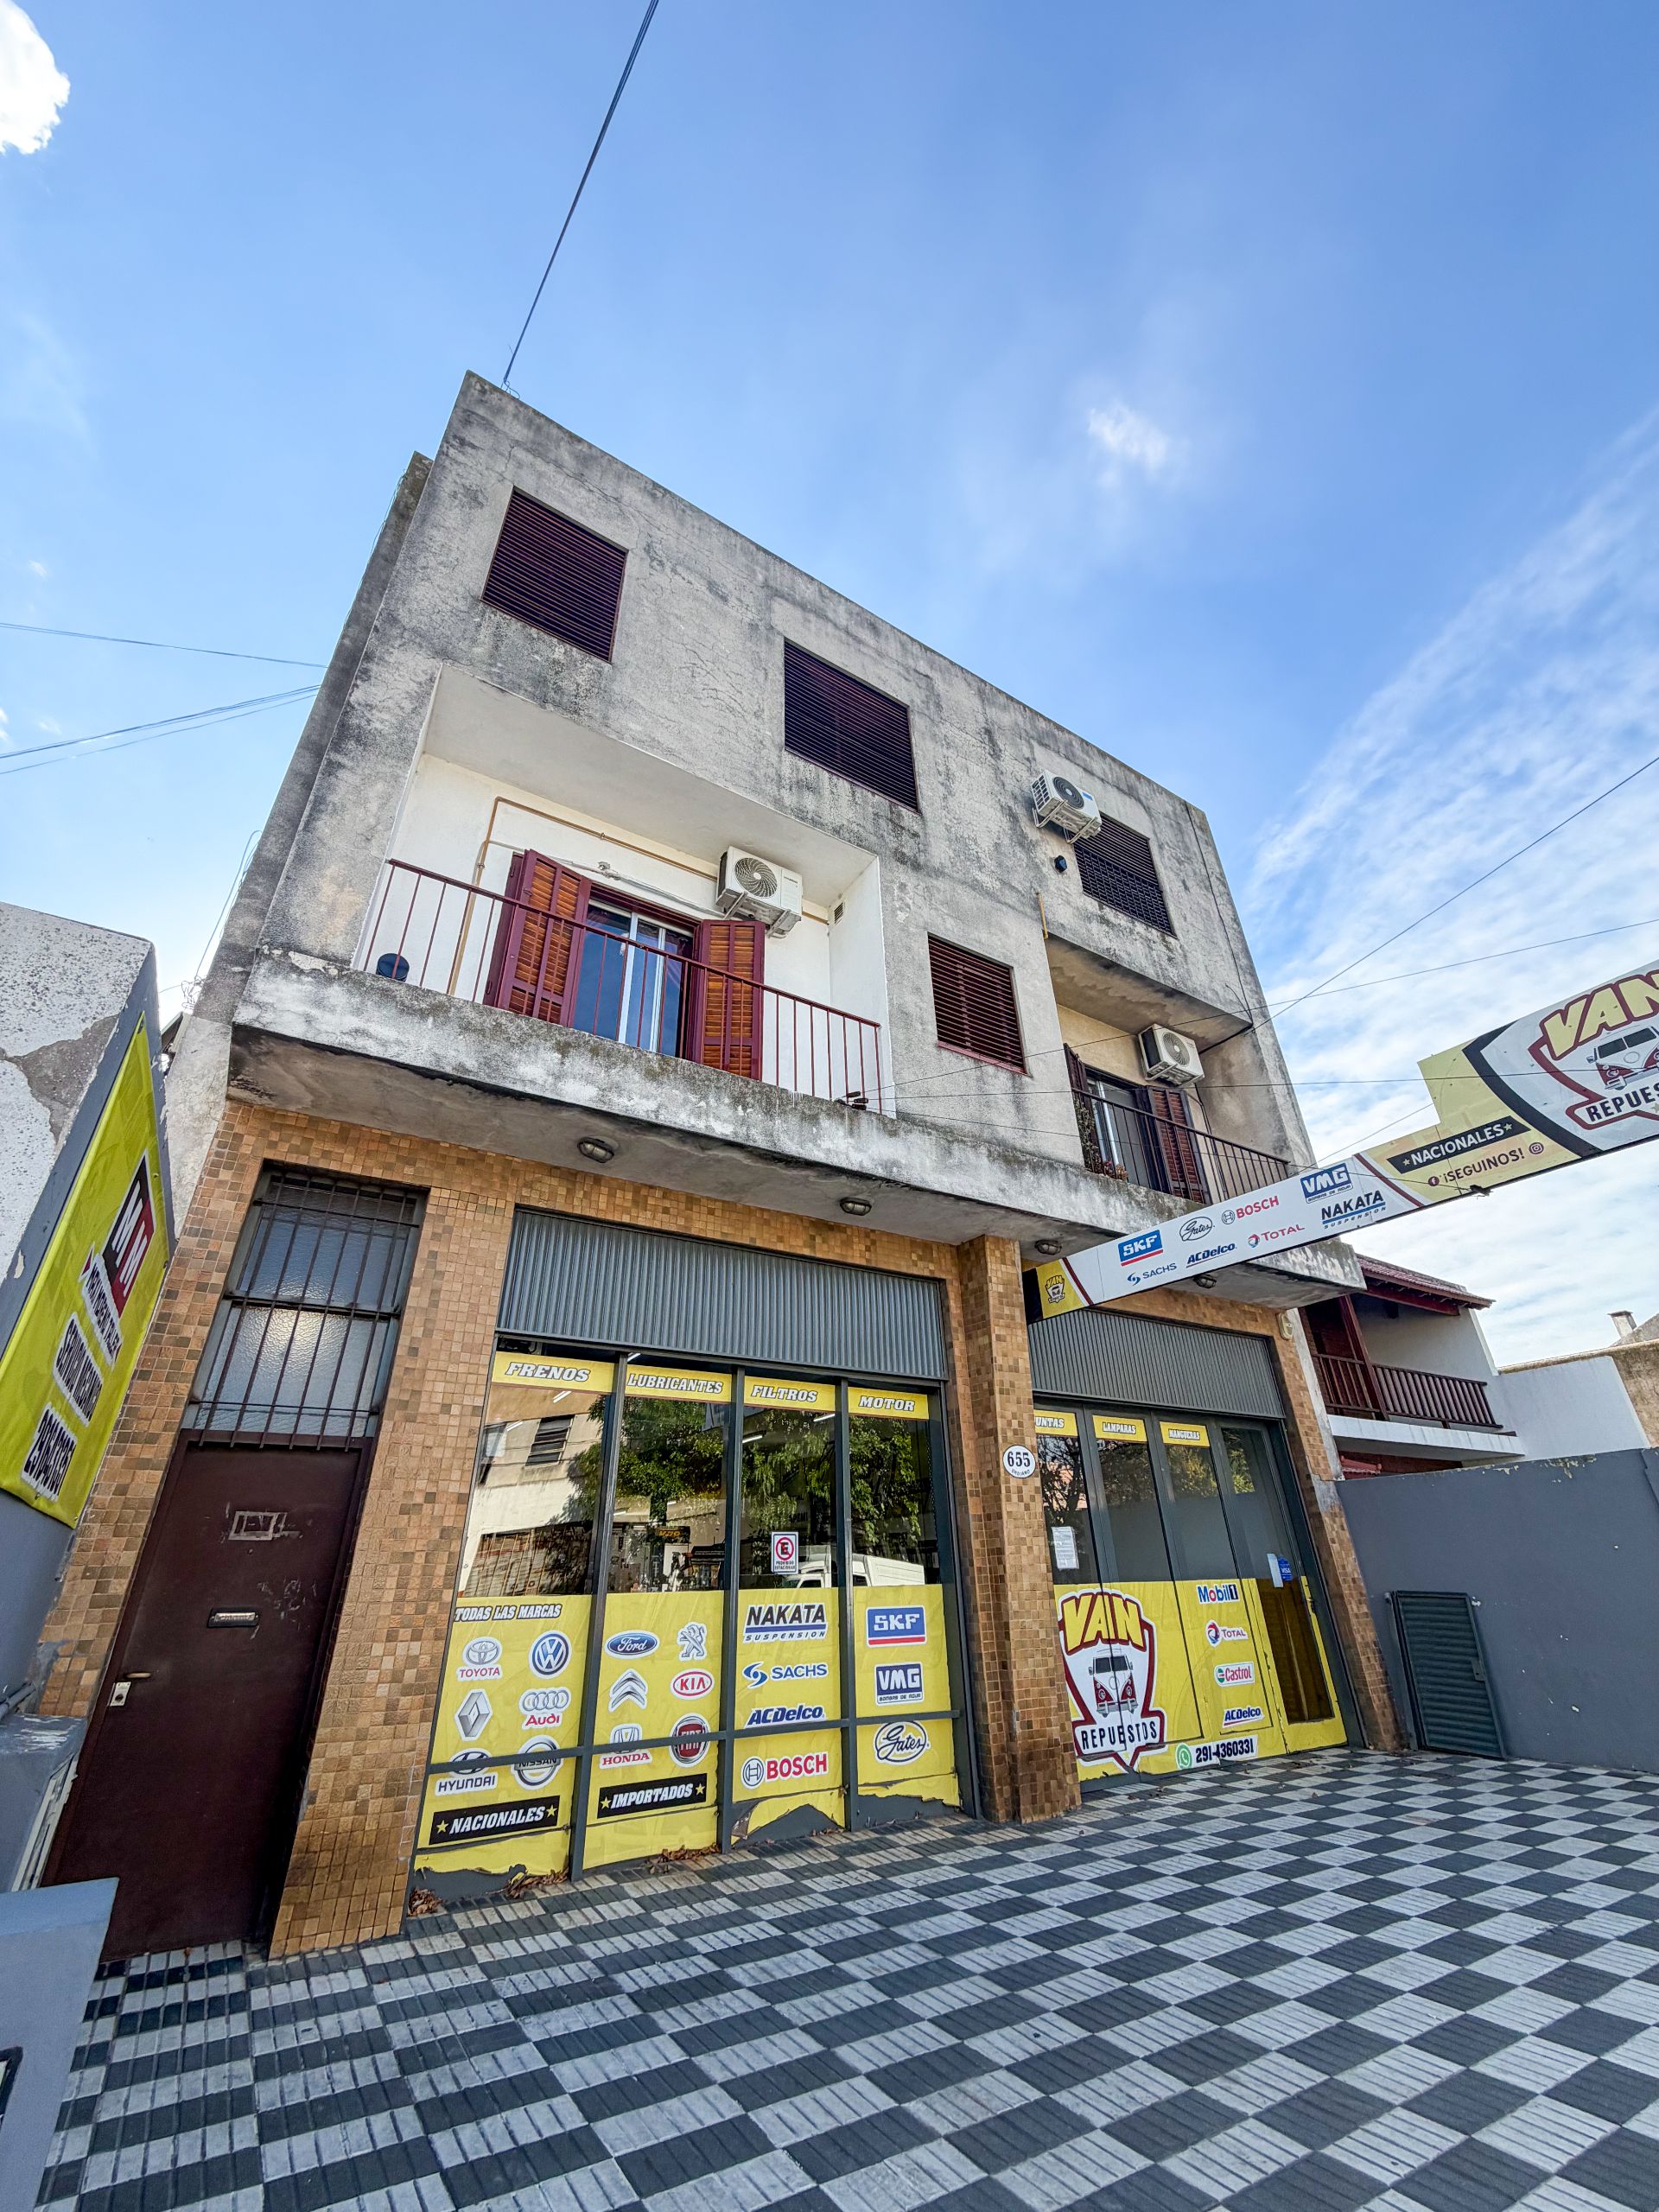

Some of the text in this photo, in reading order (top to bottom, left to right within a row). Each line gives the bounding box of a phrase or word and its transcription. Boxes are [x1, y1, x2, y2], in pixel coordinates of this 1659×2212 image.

[1541, 970, 1659, 1059] VAN
[1410, 1123, 1505, 1166] NACIONALES
[1444, 1147, 1525, 1183] ¡SEGUINOS!
[1304, 1166, 1350, 1193] VMG
[1236, 1195, 1280, 1219] BOSCH
[1321, 1190, 1384, 1220] NAKATA
[1324, 1206, 1386, 1230] SUSPENSION
[1181, 1219, 1212, 1241] Gates
[1261, 1224, 1306, 1242] TOTAL
[1123, 1234, 1158, 1256] SKF
[1187, 1243, 1236, 1264] ACDelco
[1142, 1262, 1178, 1279] SACHS
[1046, 1274, 1064, 1289] VAN
[56, 1318, 87, 1396] SERVICIO
[505, 1361, 591, 1382] FRENOS
[626, 1373, 723, 1394] LUBRICANTES
[751, 1385, 817, 1402] FILTROS
[858, 1395, 915, 1411] MOTOR
[1034, 1415, 1065, 1428] UNTAS
[1103, 1422, 1137, 1434] LAMPARAS
[1168, 1428, 1200, 1440] MANGUERAS
[23, 1408, 76, 1496] 2916431351
[1007, 1451, 1031, 1467] 655
[454, 1603, 563, 1622] TODAS LAS MARCAS
[746, 1604, 826, 1626] NAKATA
[874, 1613, 920, 1631] SKF
[1062, 1593, 1146, 1653] VAN
[745, 1631, 826, 1641] SUSPENSION
[1222, 1628, 1246, 1638] TOTAL
[617, 1636, 649, 1653] Ford
[459, 1667, 500, 1678] TOYOTA
[771, 1663, 828, 1680] SACHS
[878, 1669, 921, 1691] VMG
[1224, 1666, 1252, 1682] Castrol
[679, 1677, 706, 1691] KIA
[524, 1714, 560, 1726] Audi
[747, 1705, 823, 1726] ACDelco
[1224, 1707, 1262, 1721] ACDelco
[878, 1725, 926, 1760] Gates
[1081, 1720, 1158, 1751] REPUESTOS
[601, 1752, 650, 1765] HONDA
[1196, 1738, 1254, 1763] 291-4360331
[766, 1753, 828, 1779] BOSCH
[438, 1775, 497, 1793] HYUNDAI
[611, 1783, 694, 1808] IMPORTADOS
[449, 1806, 546, 1834] NACIONALES
